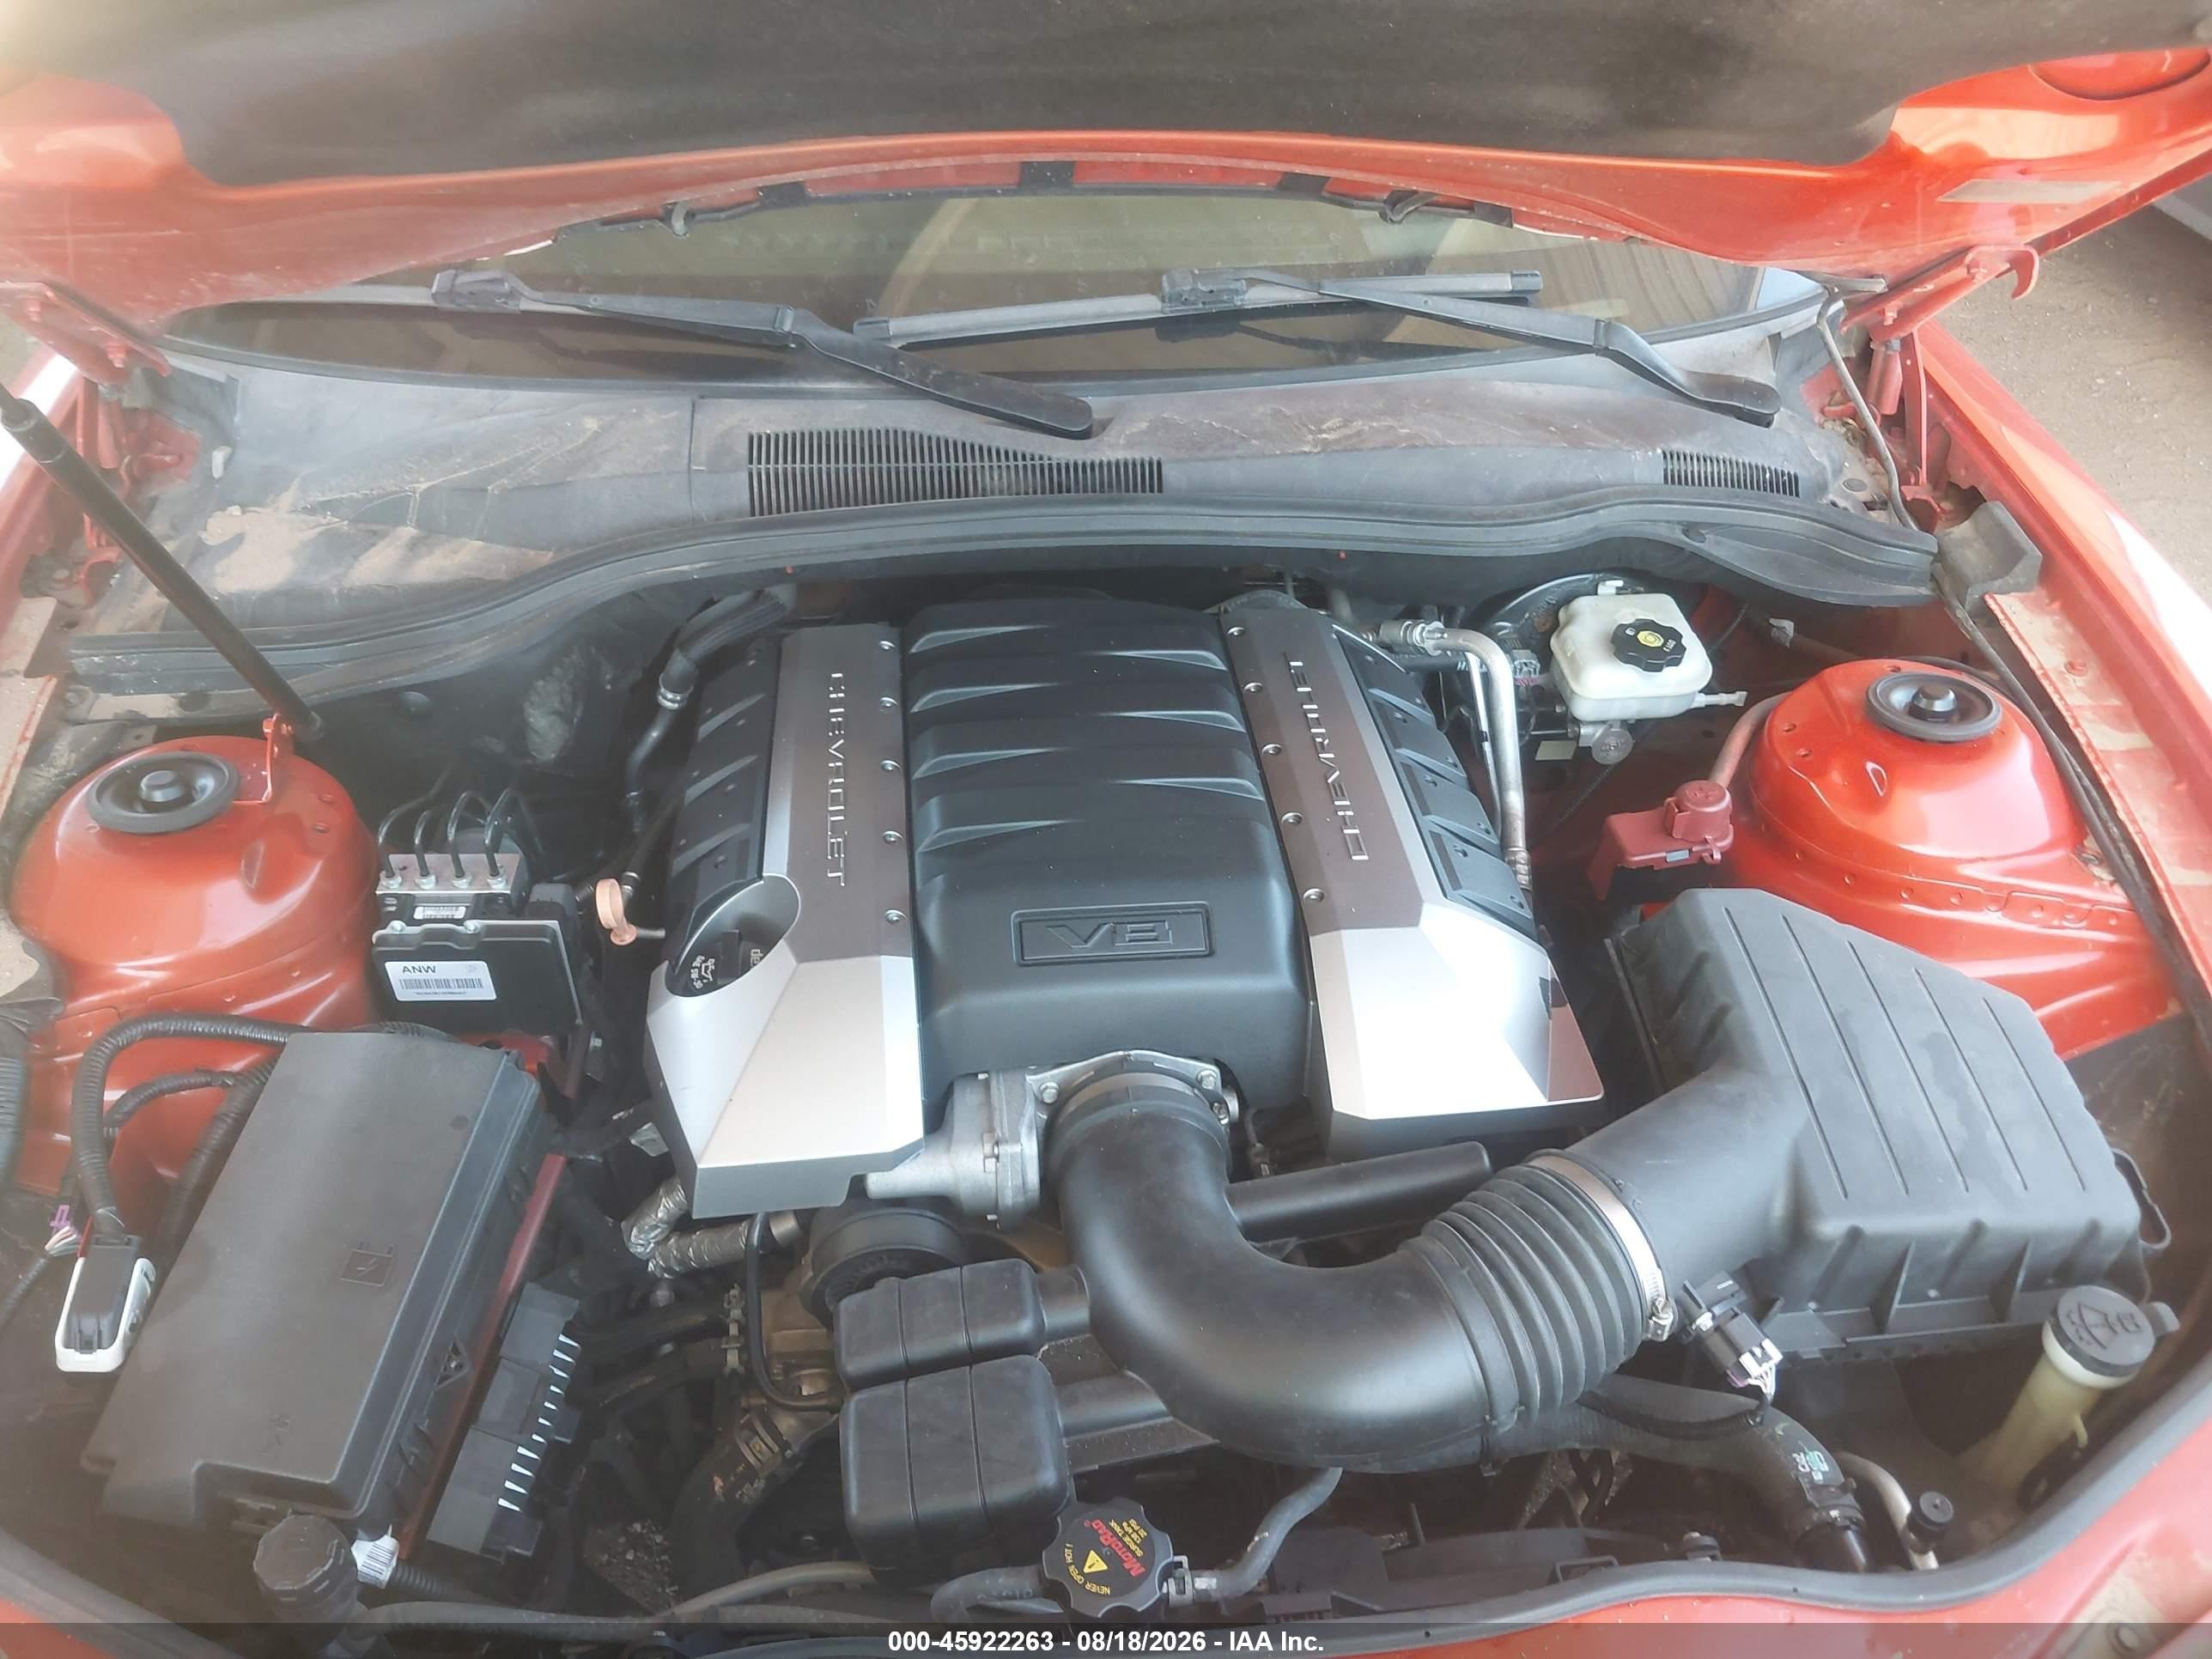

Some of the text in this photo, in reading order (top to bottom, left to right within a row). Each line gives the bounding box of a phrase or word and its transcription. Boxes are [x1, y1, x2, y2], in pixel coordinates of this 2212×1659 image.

[1283, 653, 1370, 860] CHEVROLET
[827, 672, 847, 886] CHEVROLET
[1044, 920, 1174, 949] V8
[402, 965, 436, 974] ANW
[1128, 1518, 1141, 1532] PSI
[1109, 1518, 1144, 1557] SURGE TANK
[1068, 1565, 1085, 1584] OPEN
[1085, 1581, 1111, 1595] NEVER
